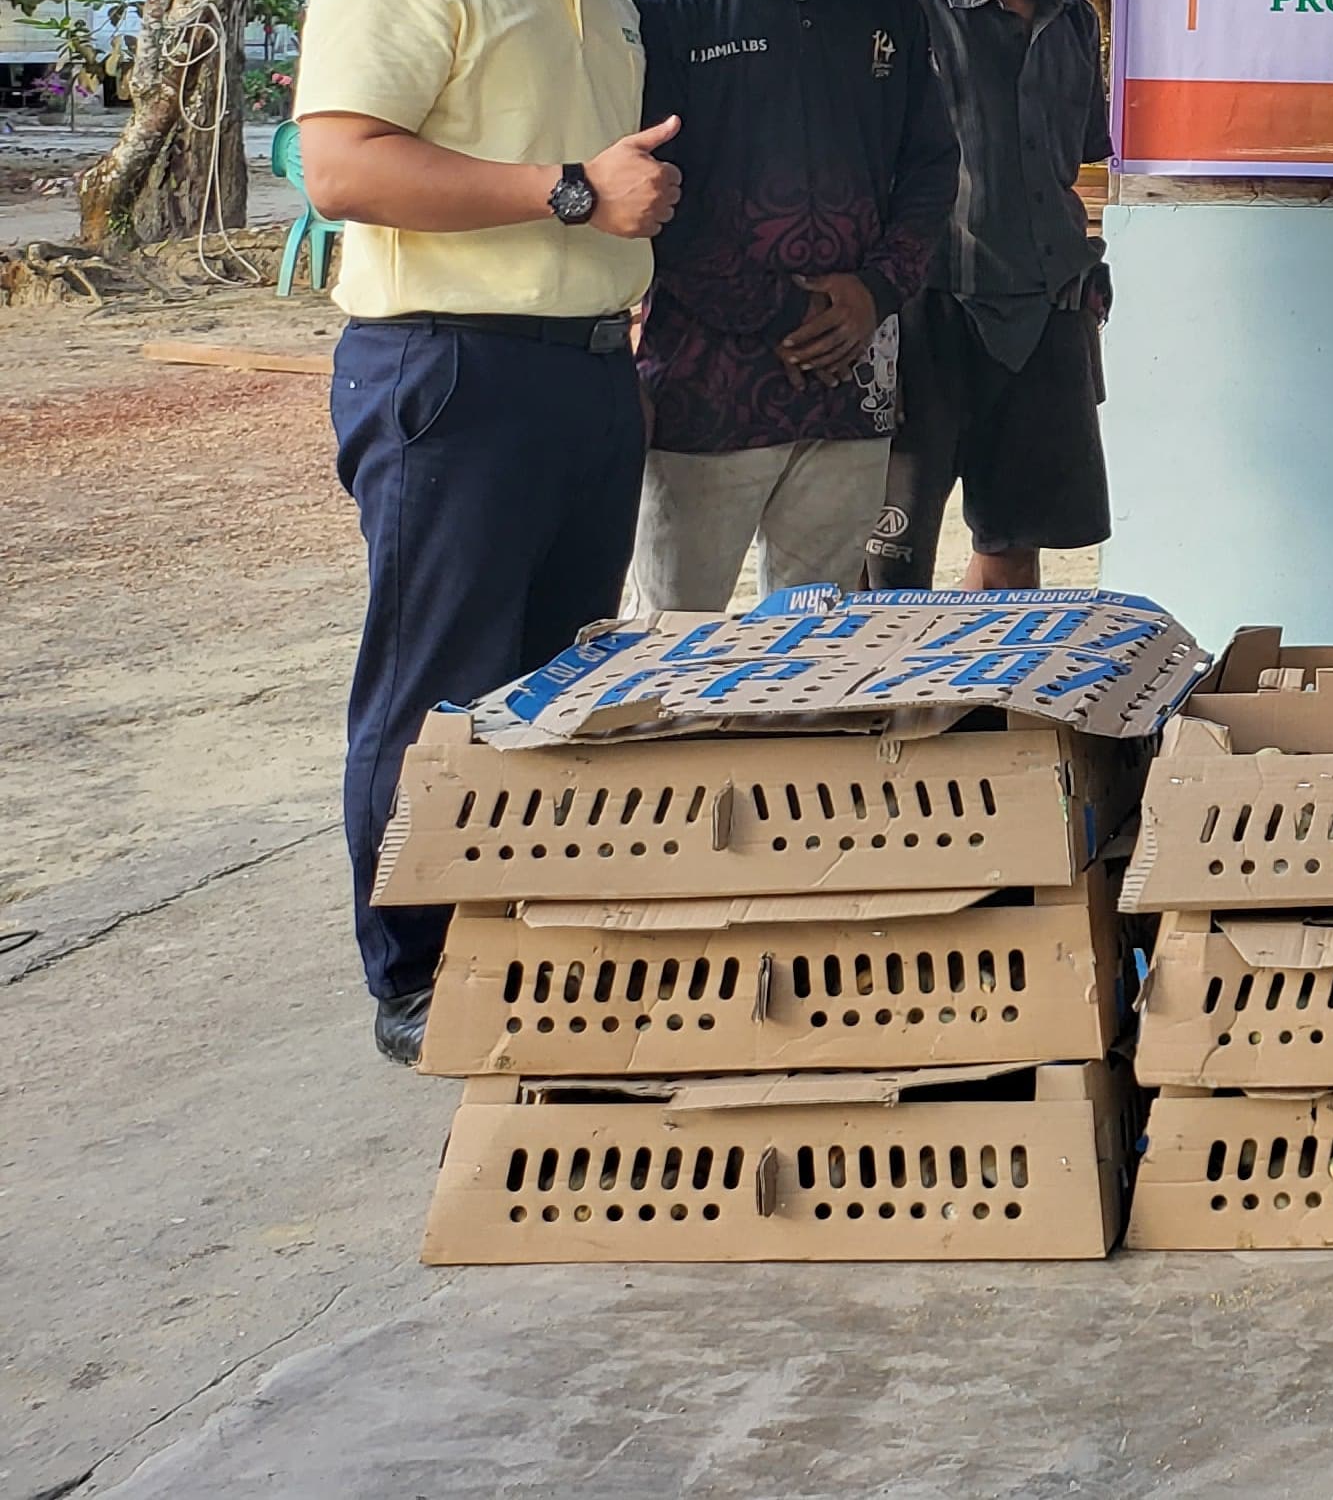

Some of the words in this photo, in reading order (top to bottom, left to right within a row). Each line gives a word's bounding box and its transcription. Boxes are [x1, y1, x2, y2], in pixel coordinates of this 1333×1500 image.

[700, 41, 740, 63] JAMIL
[741, 38, 768, 52] LBS
[865, 538, 913, 564] IGER
[897, 591, 1000, 605] POKPHAND
